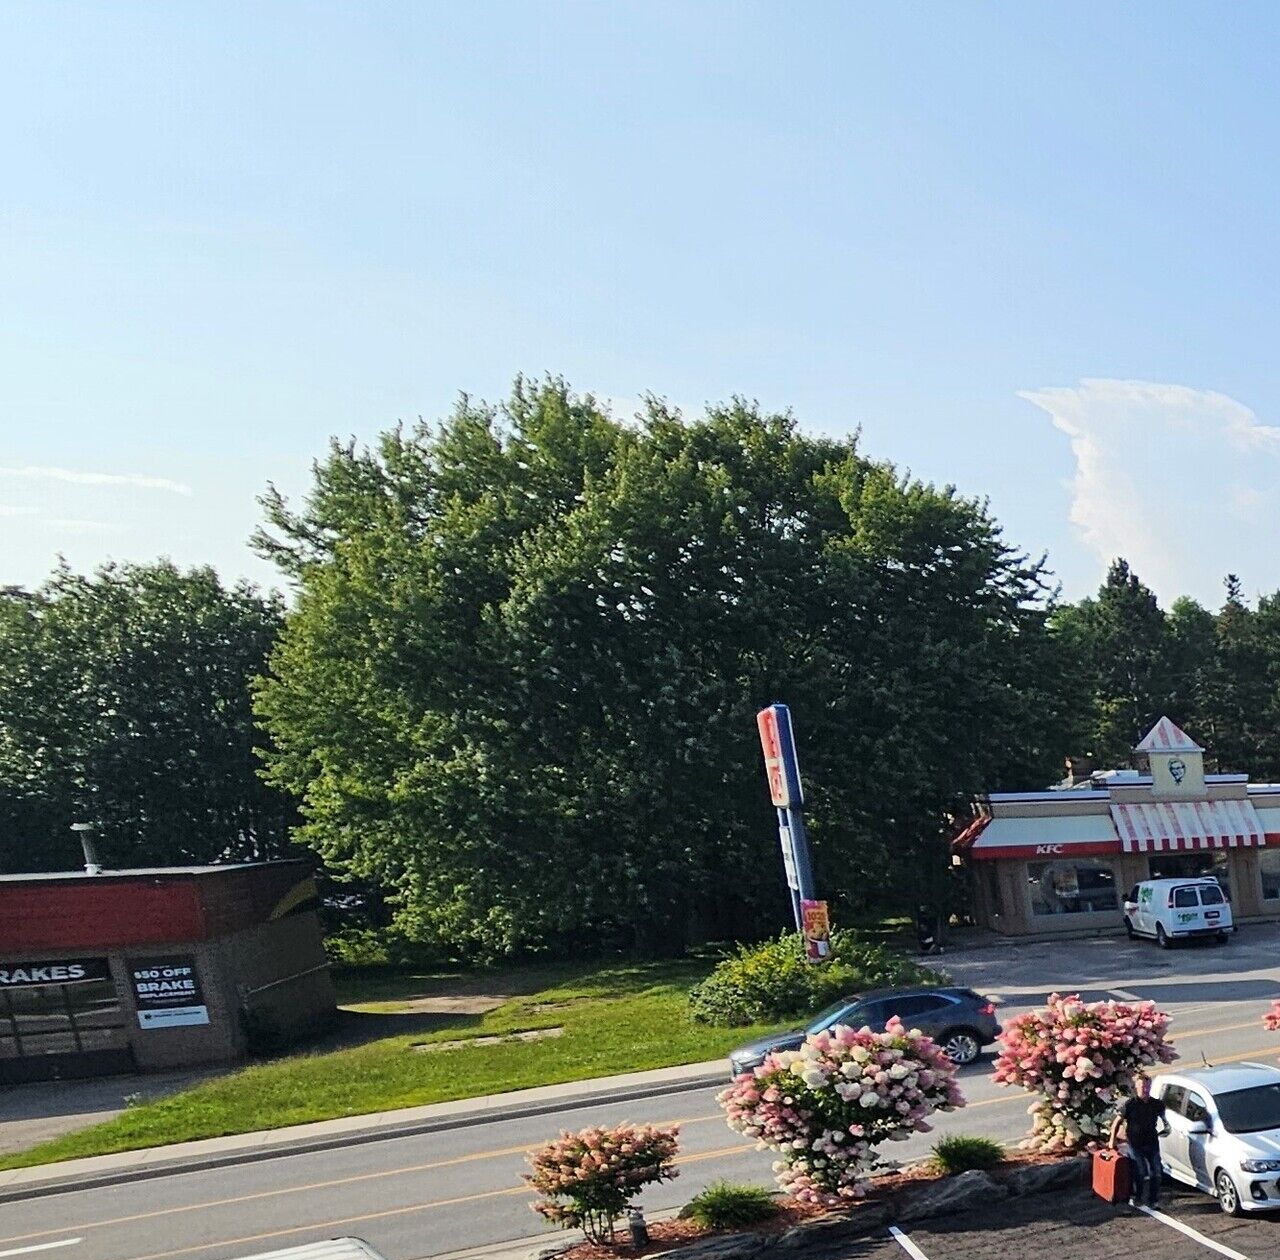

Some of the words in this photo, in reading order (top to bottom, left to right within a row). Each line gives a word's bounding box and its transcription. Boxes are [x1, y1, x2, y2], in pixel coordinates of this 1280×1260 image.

[1036, 844, 1064, 854] KFC
[162, 967, 192, 978] OFF
[137, 979, 195, 993] BRAKE
